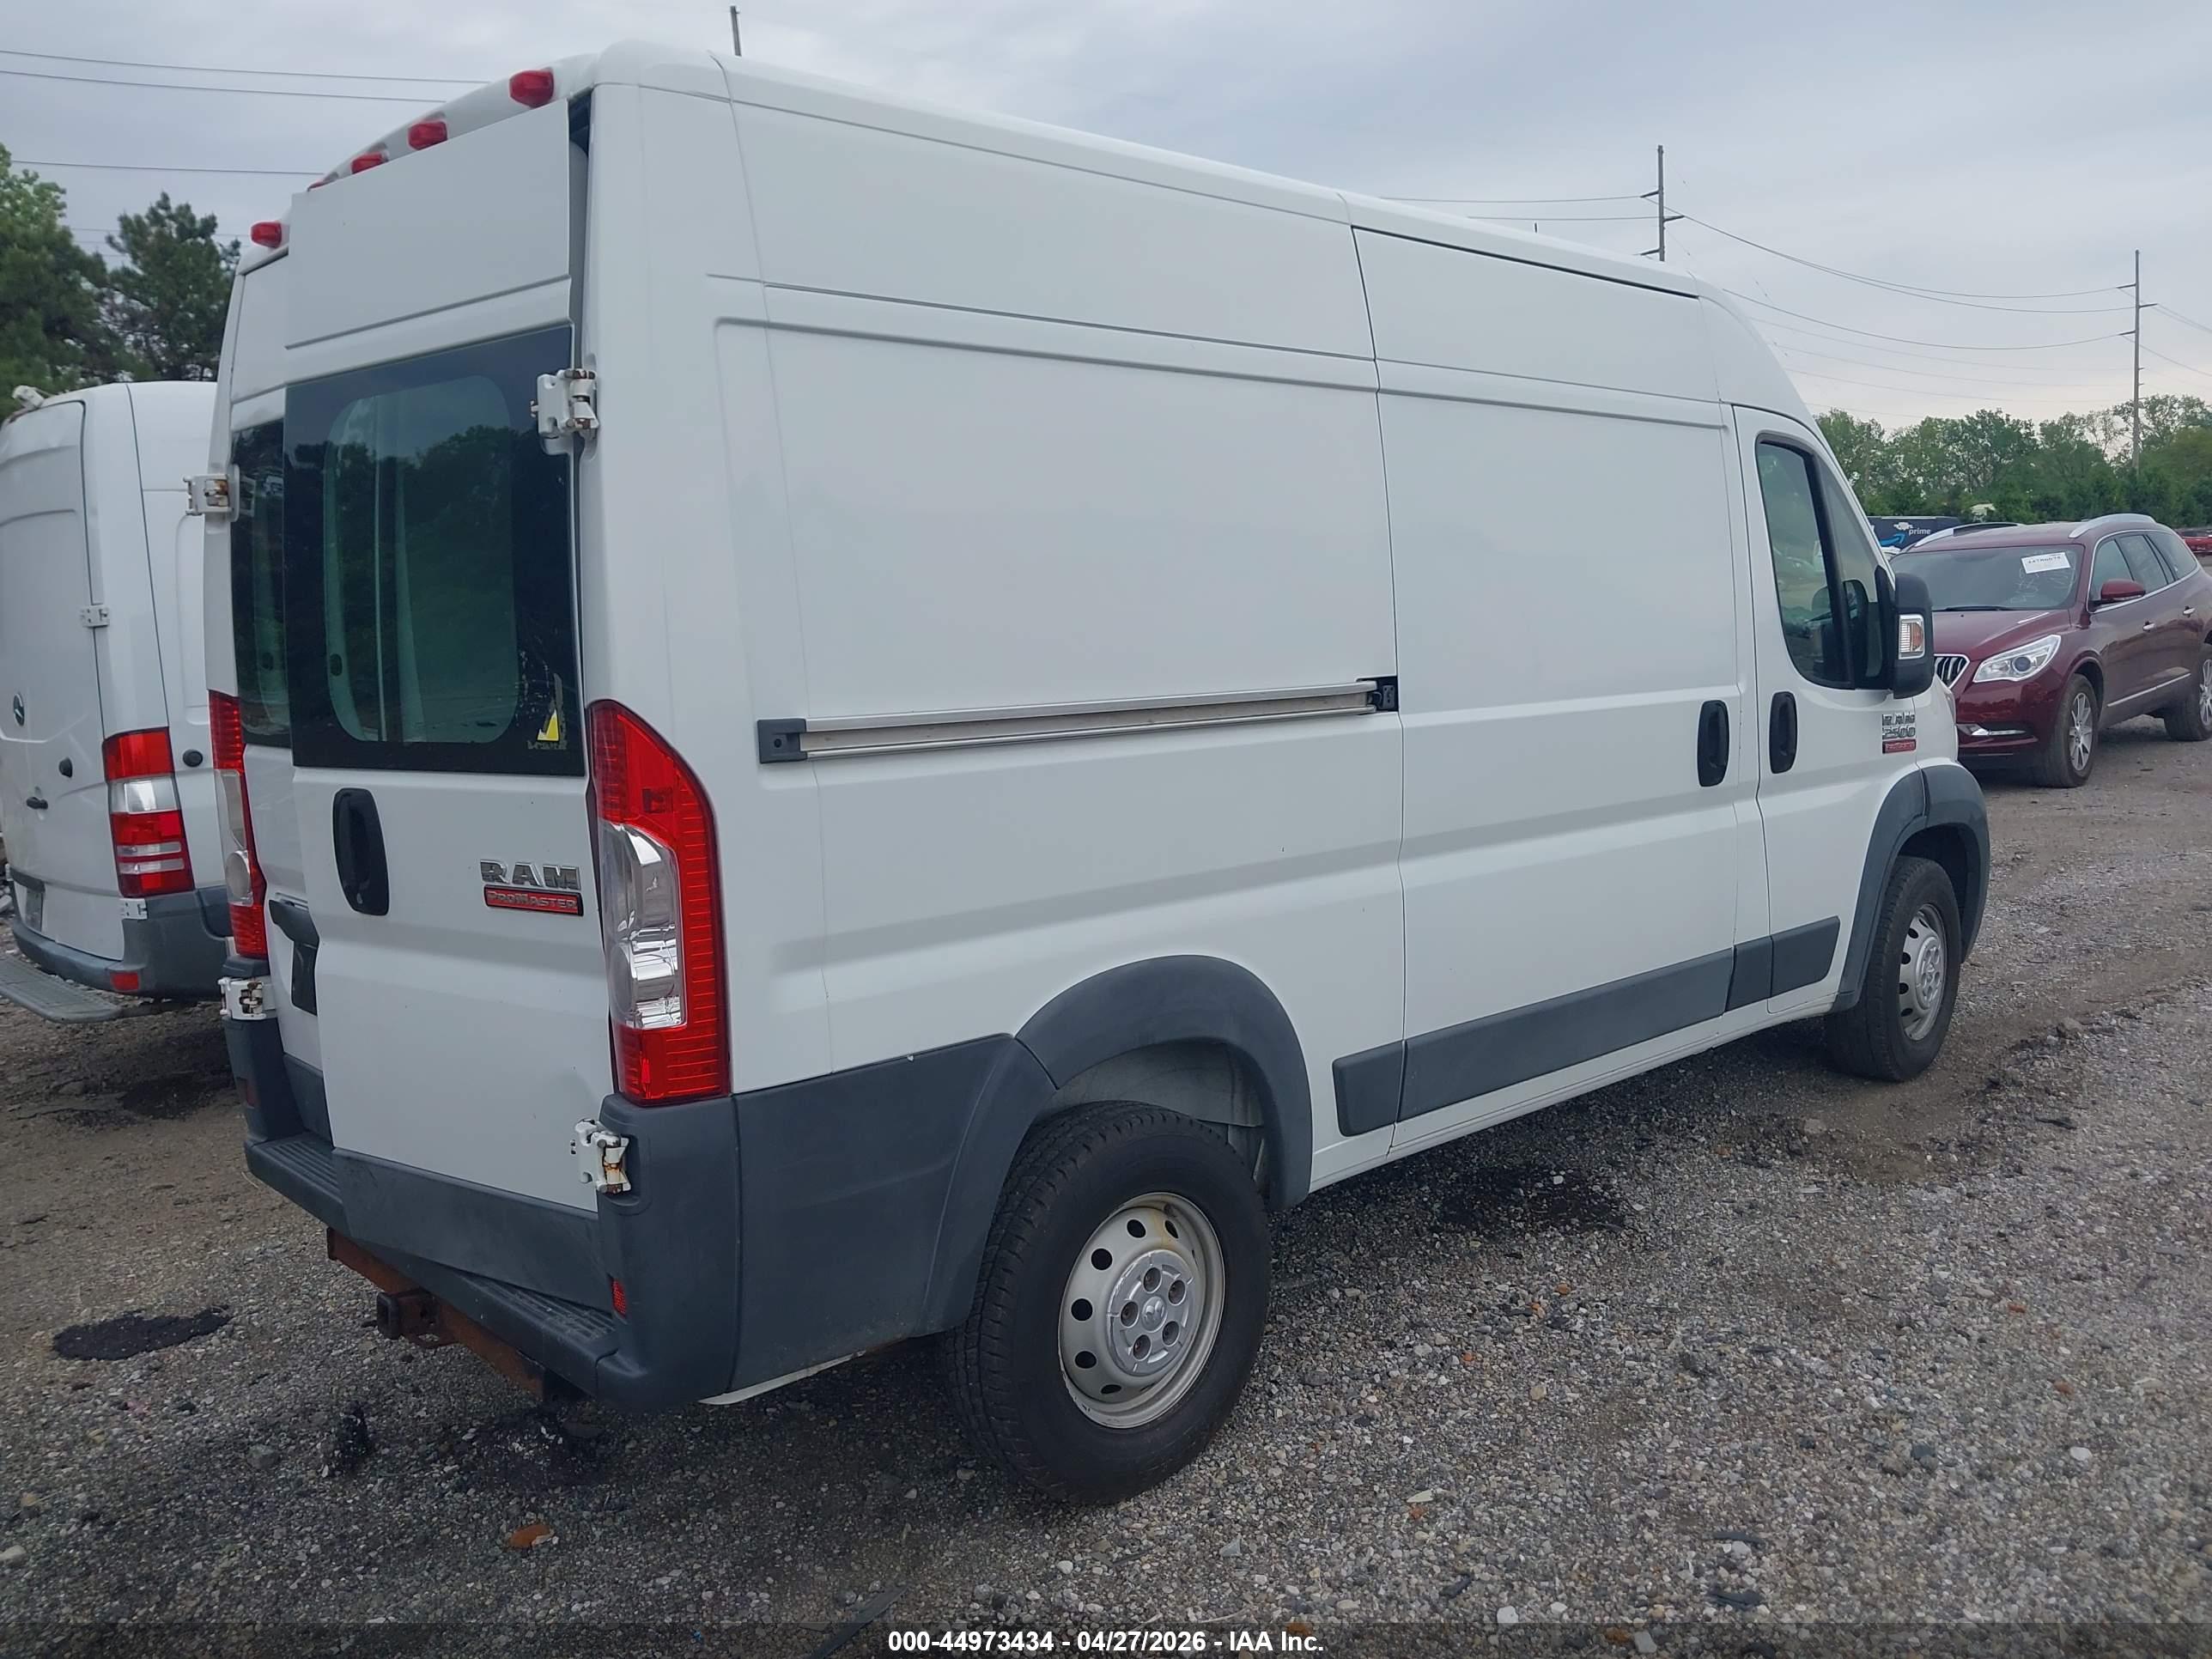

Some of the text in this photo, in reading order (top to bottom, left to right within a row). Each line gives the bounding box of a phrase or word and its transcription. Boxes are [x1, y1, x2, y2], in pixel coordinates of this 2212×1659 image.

[1908, 527, 1931, 536] prime
[1882, 726, 1916, 739] 2500
[480, 860, 581, 890] RAM
